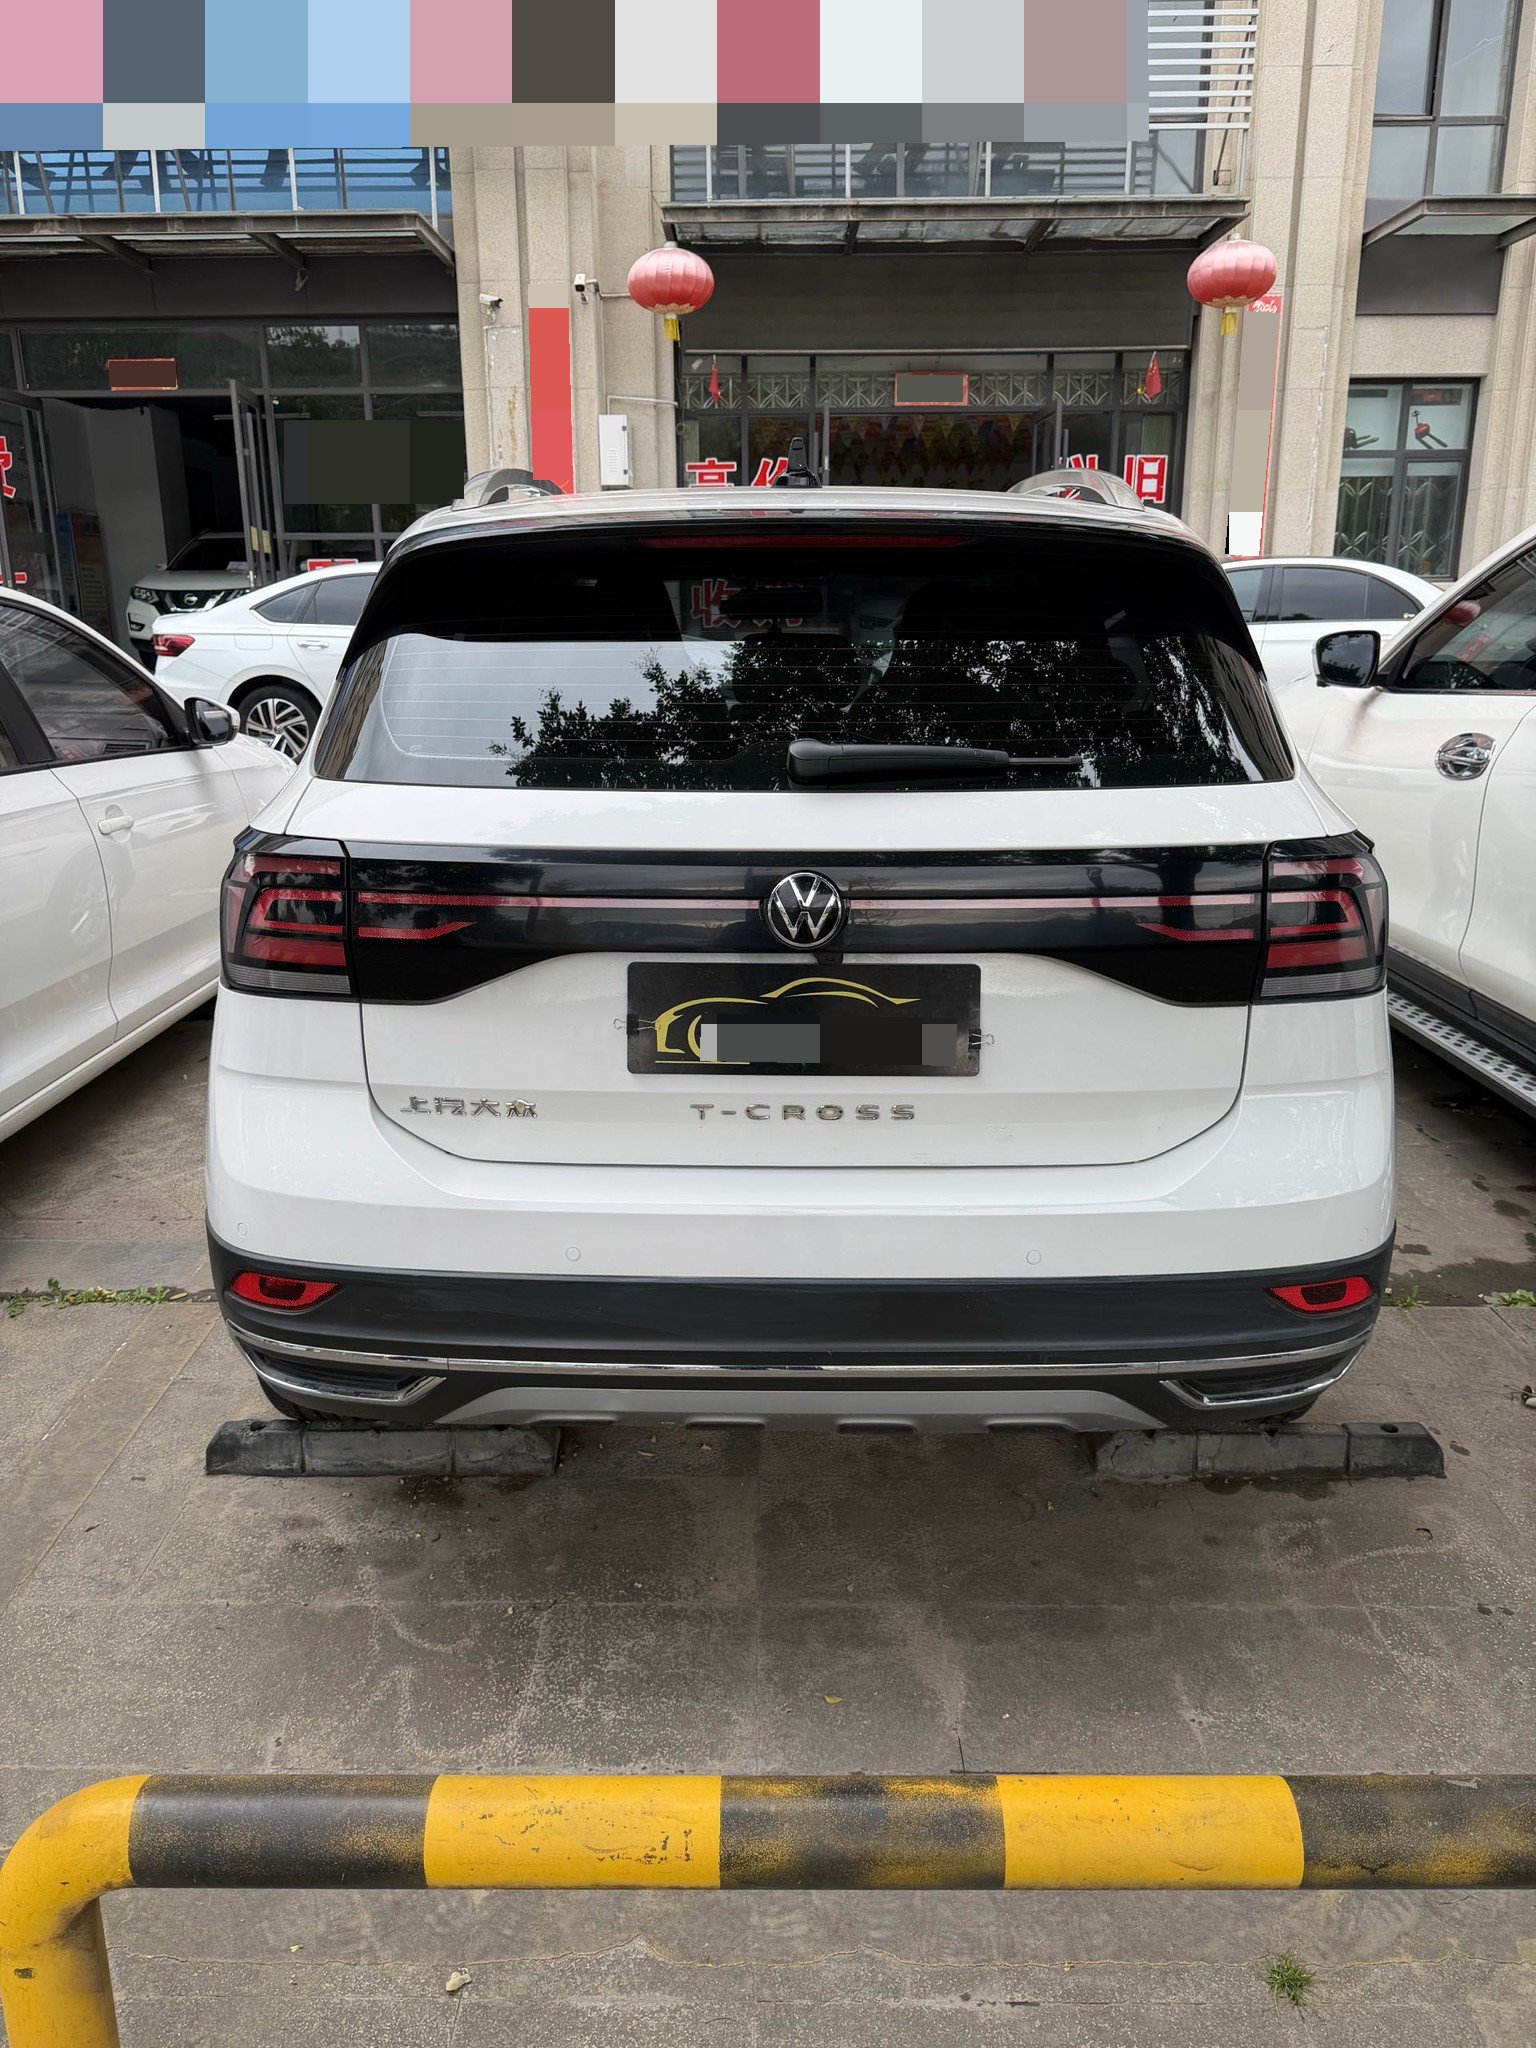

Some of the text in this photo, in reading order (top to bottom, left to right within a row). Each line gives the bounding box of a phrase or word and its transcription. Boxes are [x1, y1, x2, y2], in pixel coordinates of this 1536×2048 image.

[400, 1095, 538, 1118] 上汽大众
[689, 1103, 916, 1121] T-CROSS
